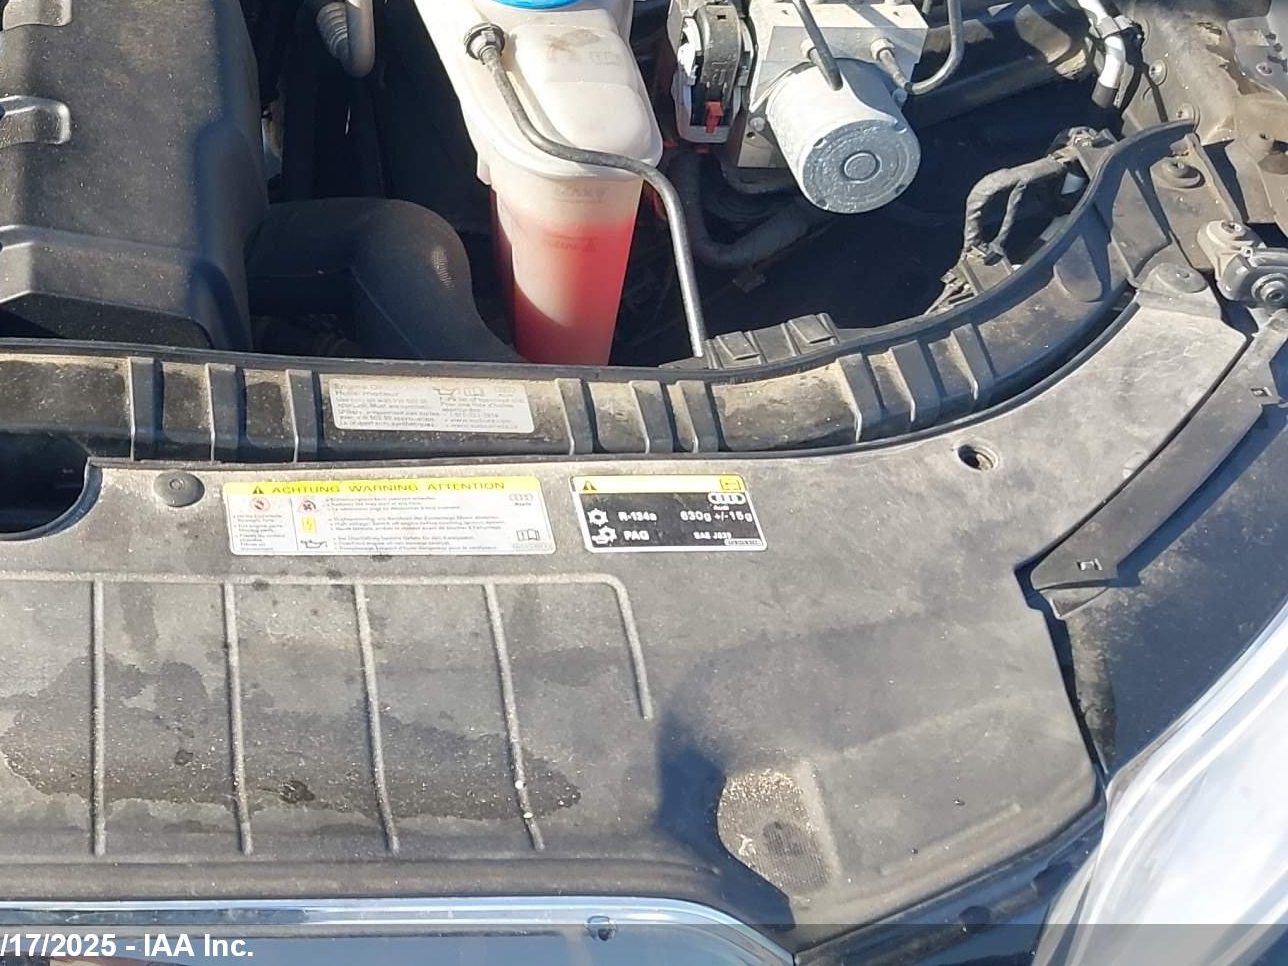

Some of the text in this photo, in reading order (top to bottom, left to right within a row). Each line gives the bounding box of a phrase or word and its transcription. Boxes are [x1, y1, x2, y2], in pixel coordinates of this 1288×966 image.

[272, 482, 505, 494] ACHTUNG WARNING ATTENTION
[618, 511, 658, 522] R-134a
[623, 530, 650, 541] PAG
